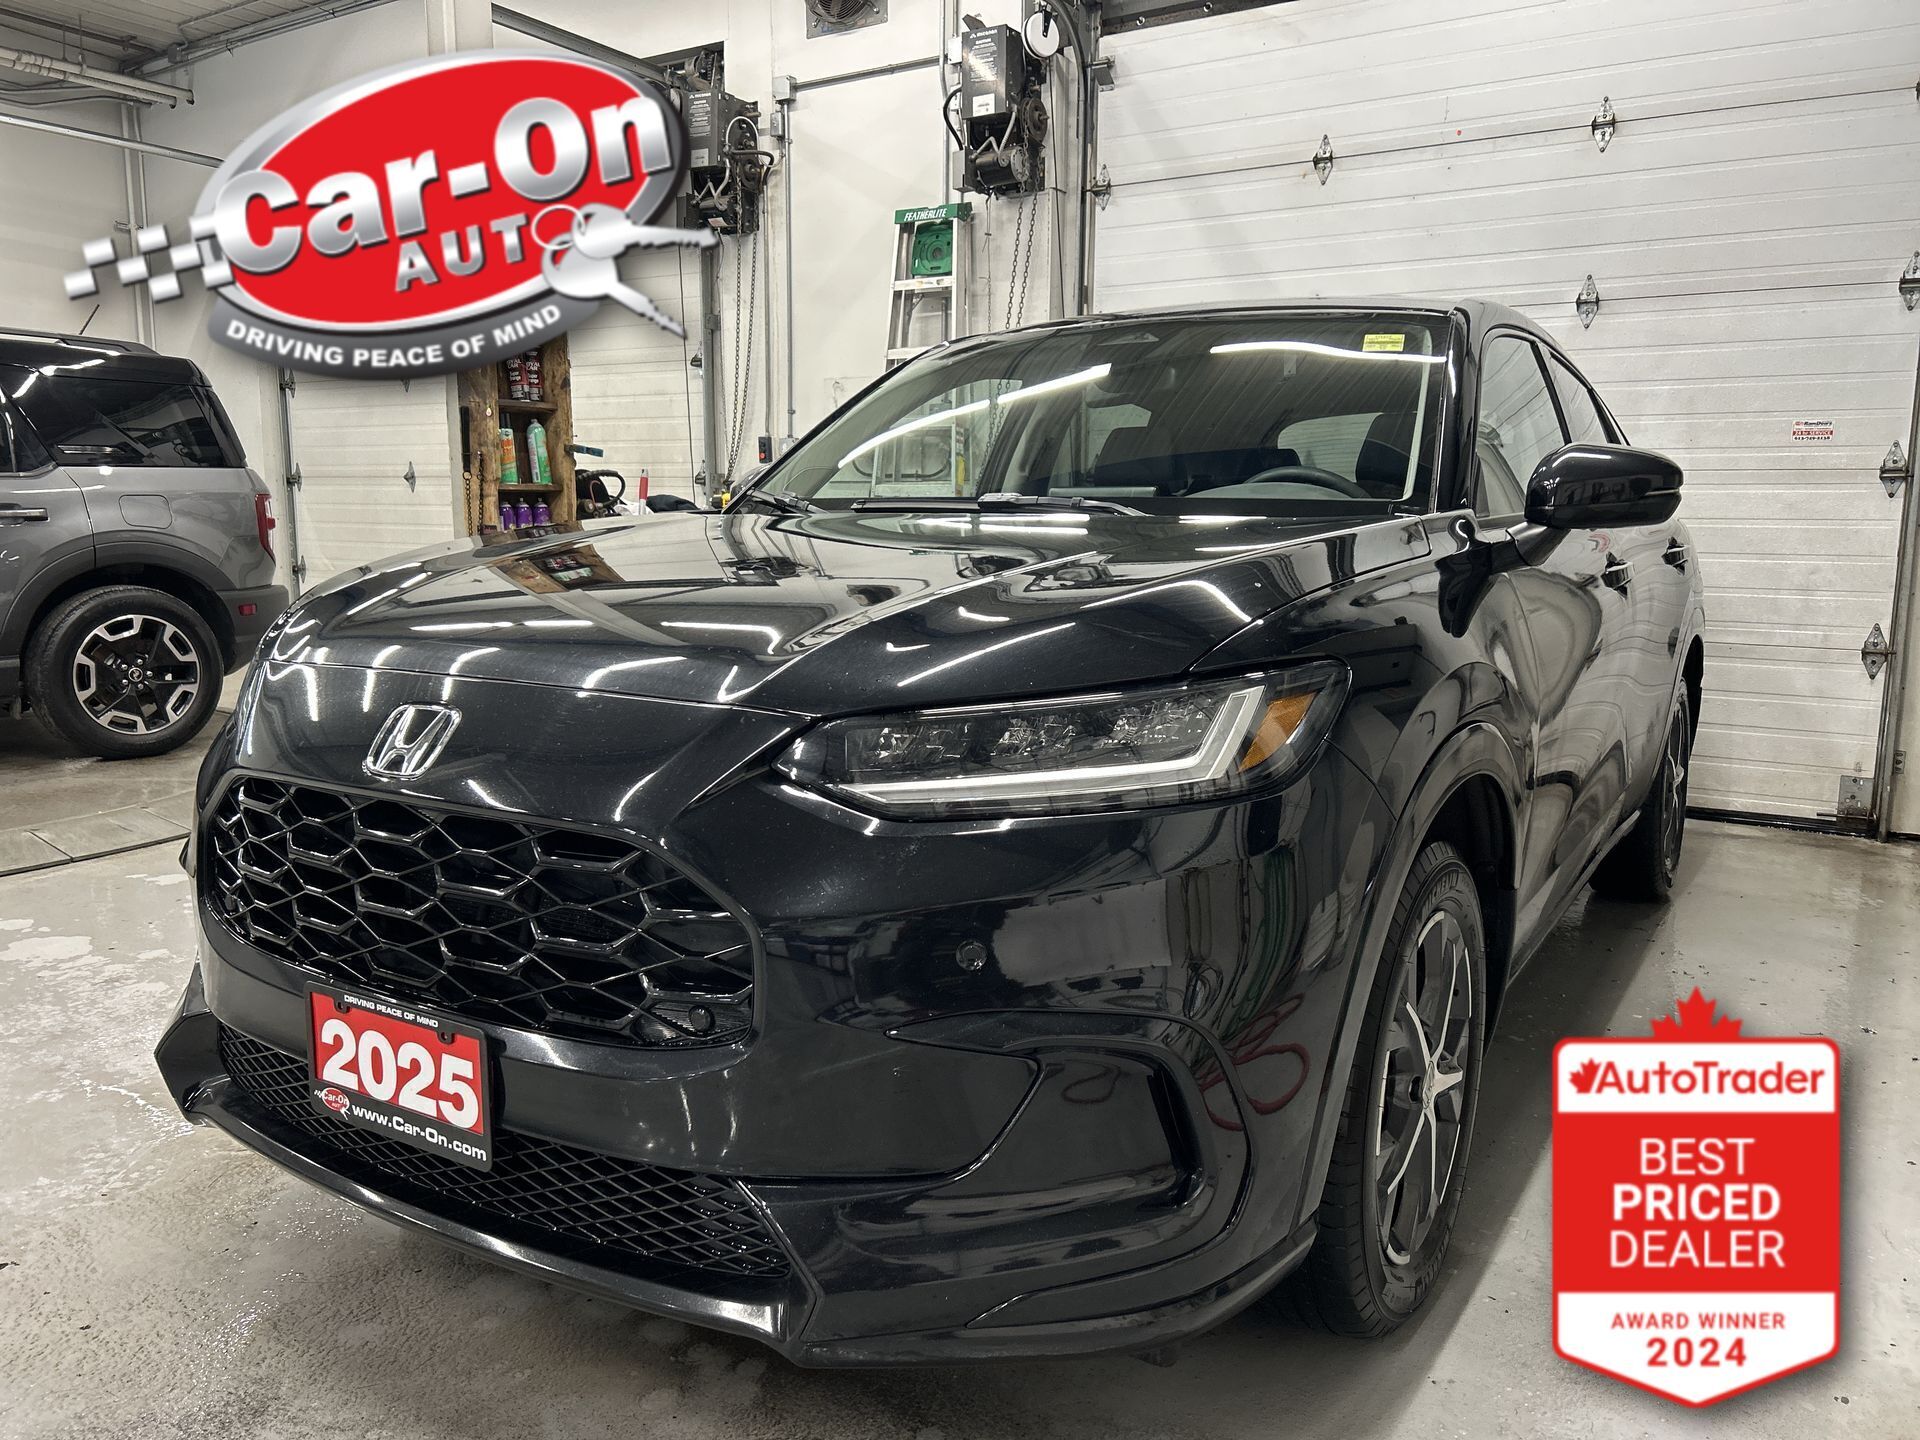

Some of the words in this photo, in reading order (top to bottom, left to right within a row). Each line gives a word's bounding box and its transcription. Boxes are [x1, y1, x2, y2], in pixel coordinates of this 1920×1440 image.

[904, 208, 947, 221] FEATHERLITE
[343, 994, 375, 1010] DRIVING
[376, 1004, 403, 1018] PEACE
[404, 1011, 415, 1021] OF
[416, 1016, 439, 1028] MIND
[321, 1018, 480, 1129] 2025
[351, 1104, 487, 1162] www.Car-On.com
